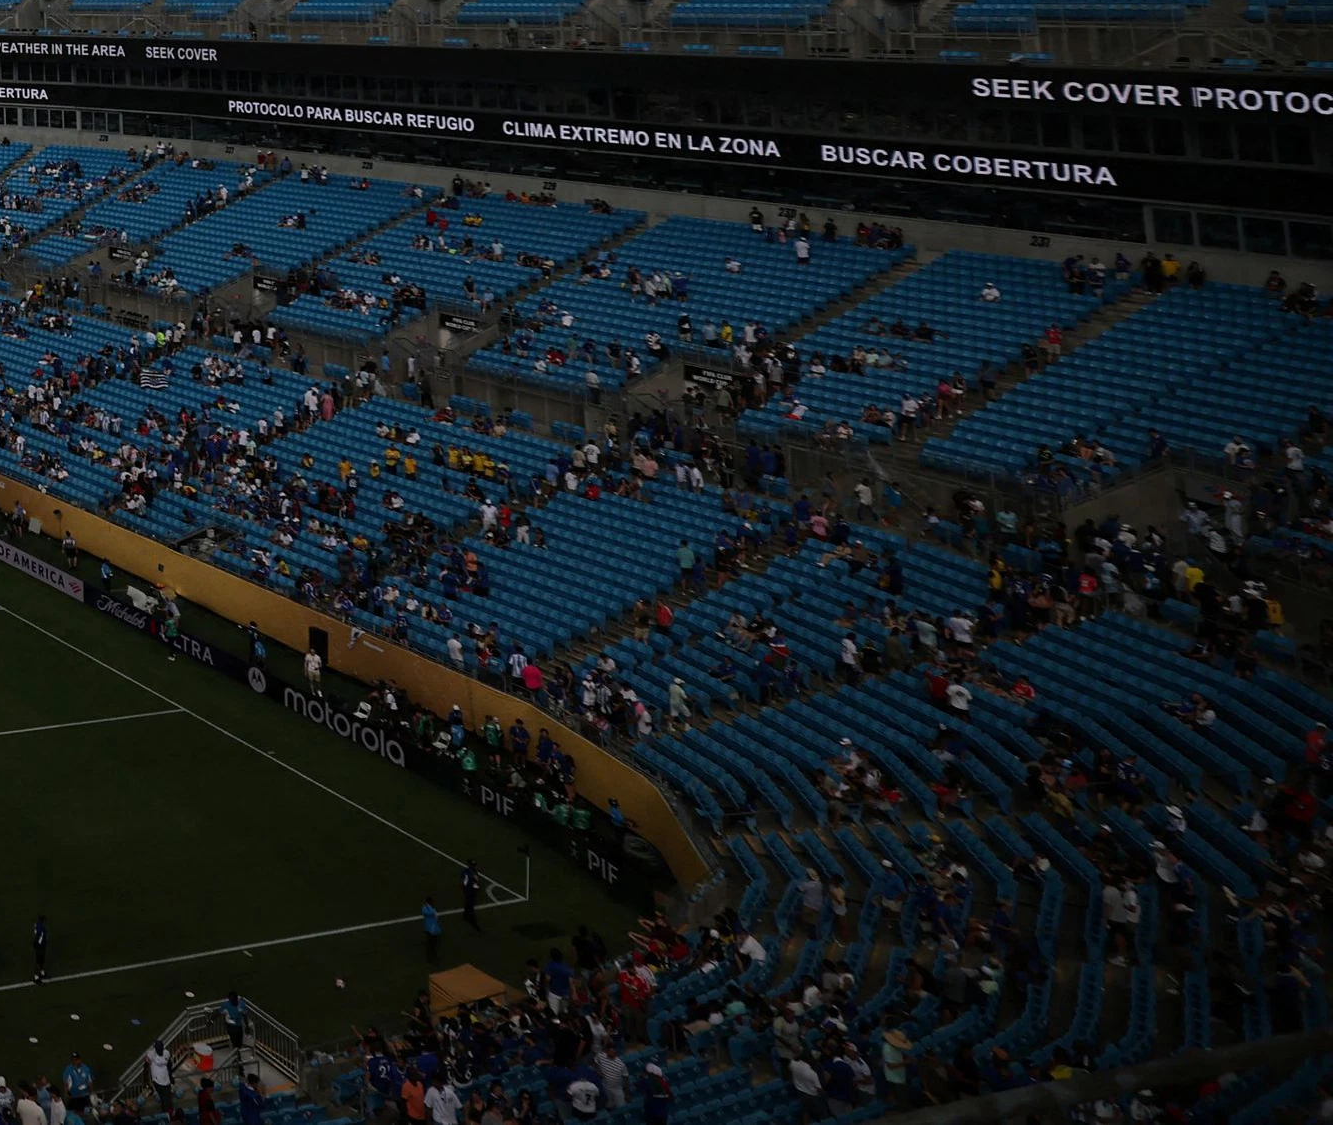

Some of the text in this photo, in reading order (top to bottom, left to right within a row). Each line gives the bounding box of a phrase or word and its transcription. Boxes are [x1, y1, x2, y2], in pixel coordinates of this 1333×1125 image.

[51, 43, 63, 55] IN
[65, 43, 89, 56] THE
[91, 44, 126, 57] AREA
[145, 46, 175, 60] SEEK
[177, 47, 218, 61] COVER
[972, 78, 1333, 115] SEEK COVER PROTOC
[228, 100, 1117, 186] PROTOCOLO PARA BUSCAR REFUGIO CLIMA EXTREMO EN LA ZONA BUSCAR COBERTURA
[13, 552, 65, 588] AMERICA
[95, 594, 147, 631] Michelob
[284, 686, 407, 768] motorola
[480, 785, 516, 819] PIF
[587, 849, 620, 885] PIF
